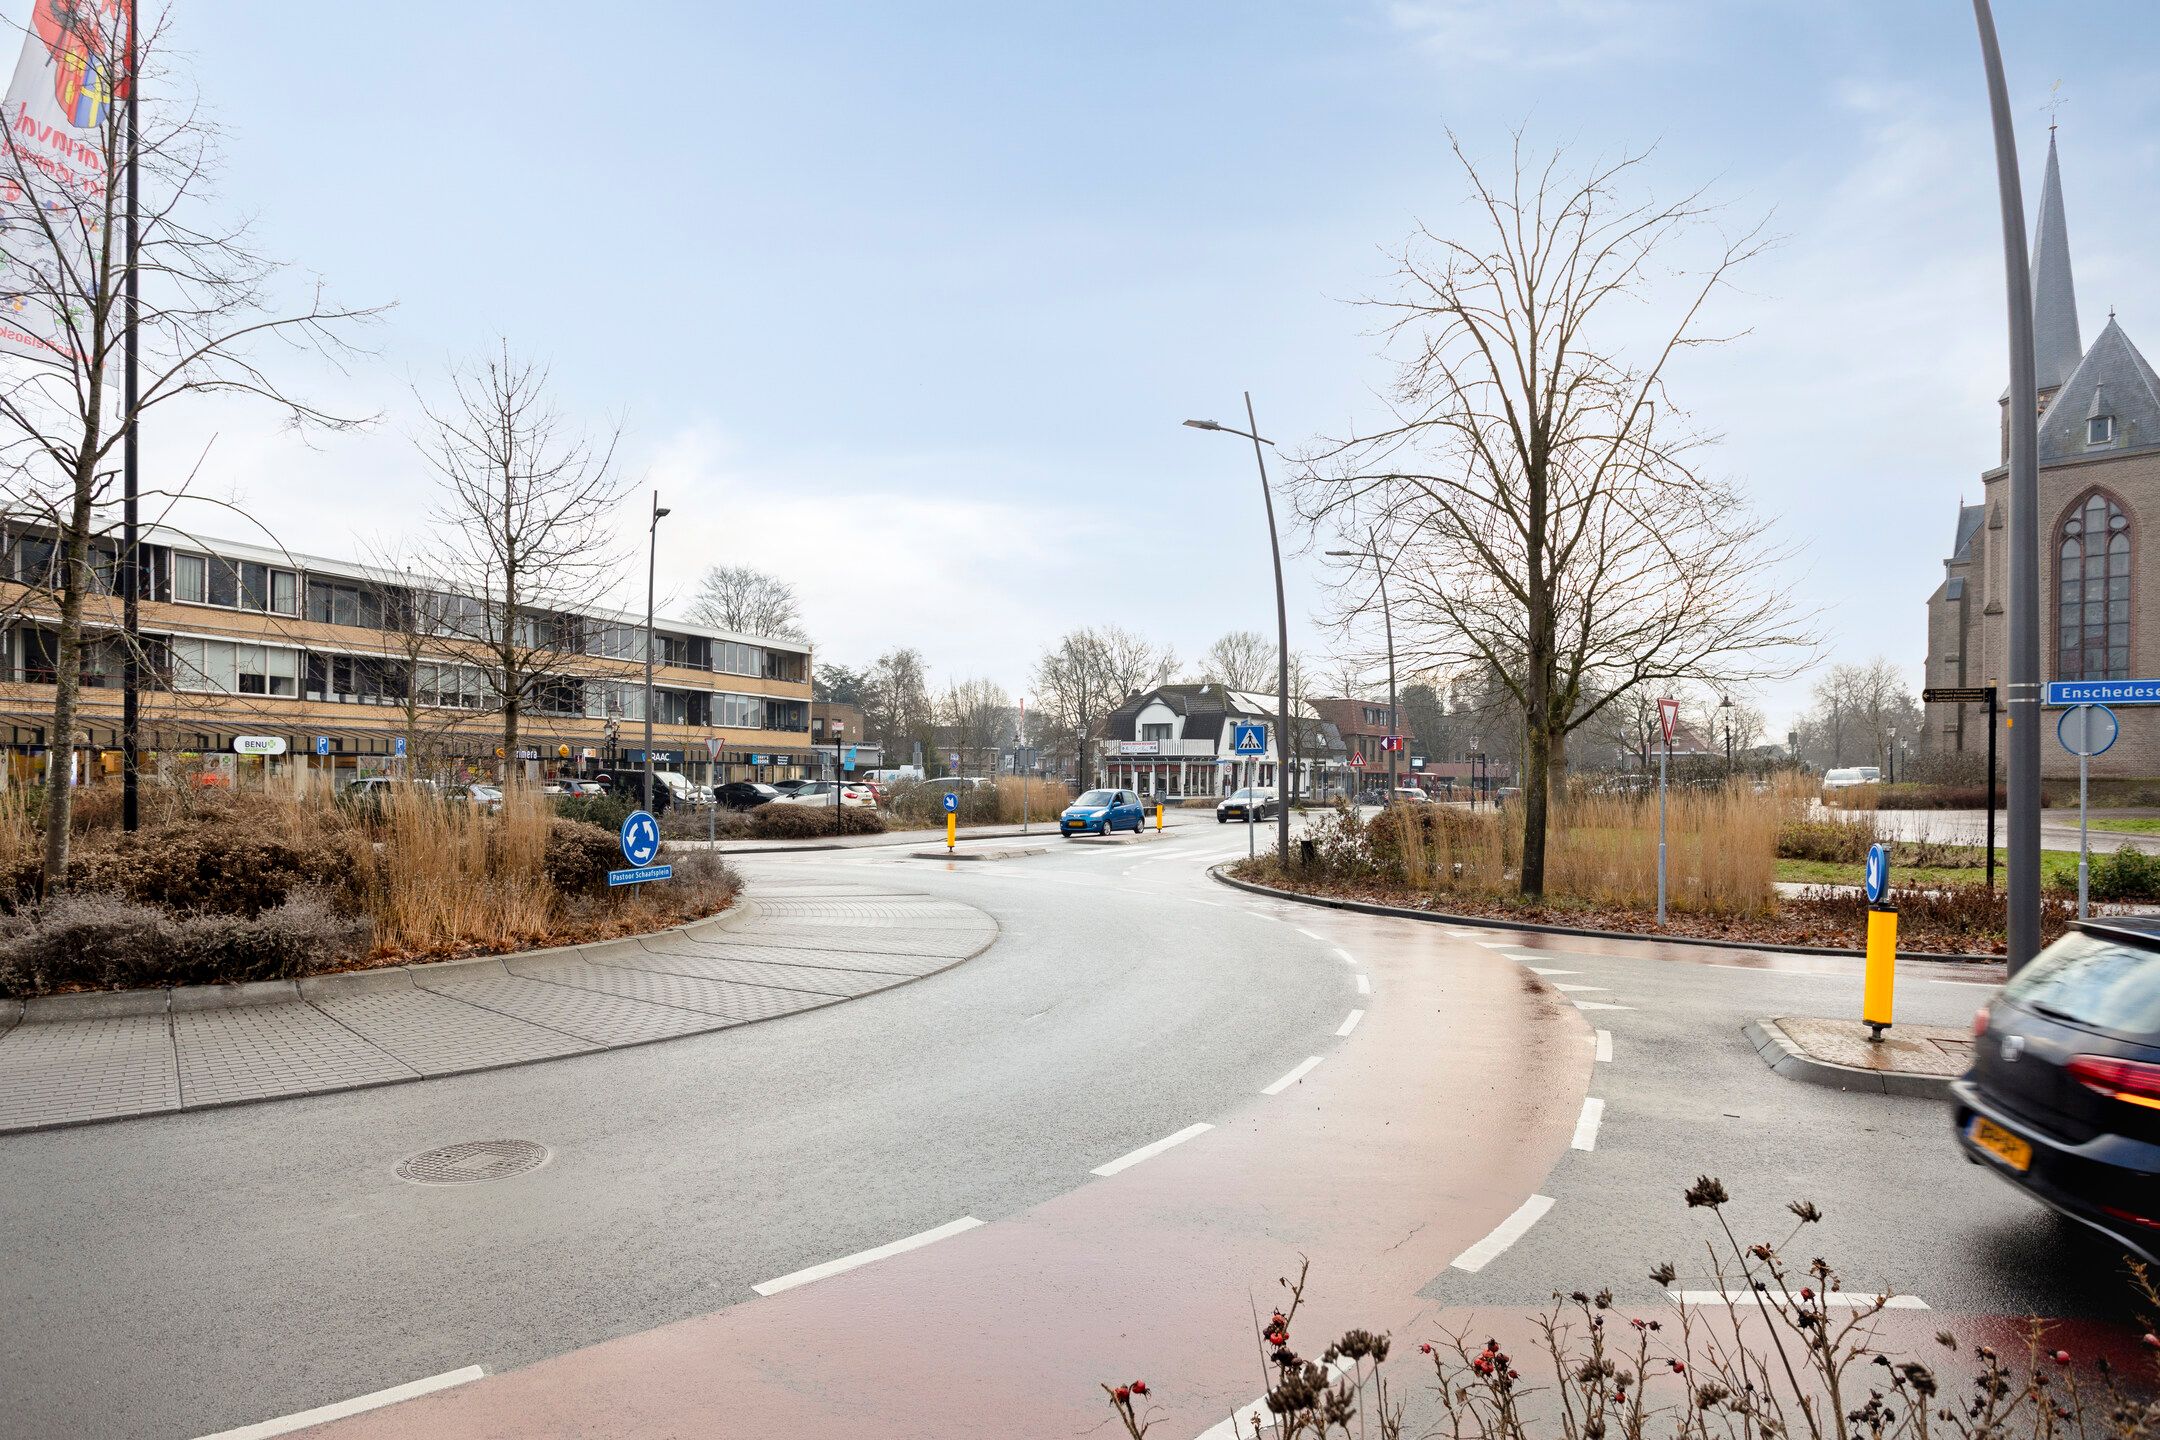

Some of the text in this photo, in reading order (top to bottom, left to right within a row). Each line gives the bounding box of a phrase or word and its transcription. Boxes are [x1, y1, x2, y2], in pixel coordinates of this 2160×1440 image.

[244, 740, 267, 748] BENU
[515, 749, 538, 759] rimera
[612, 869, 670, 882] Pastoor Schaafsplein
